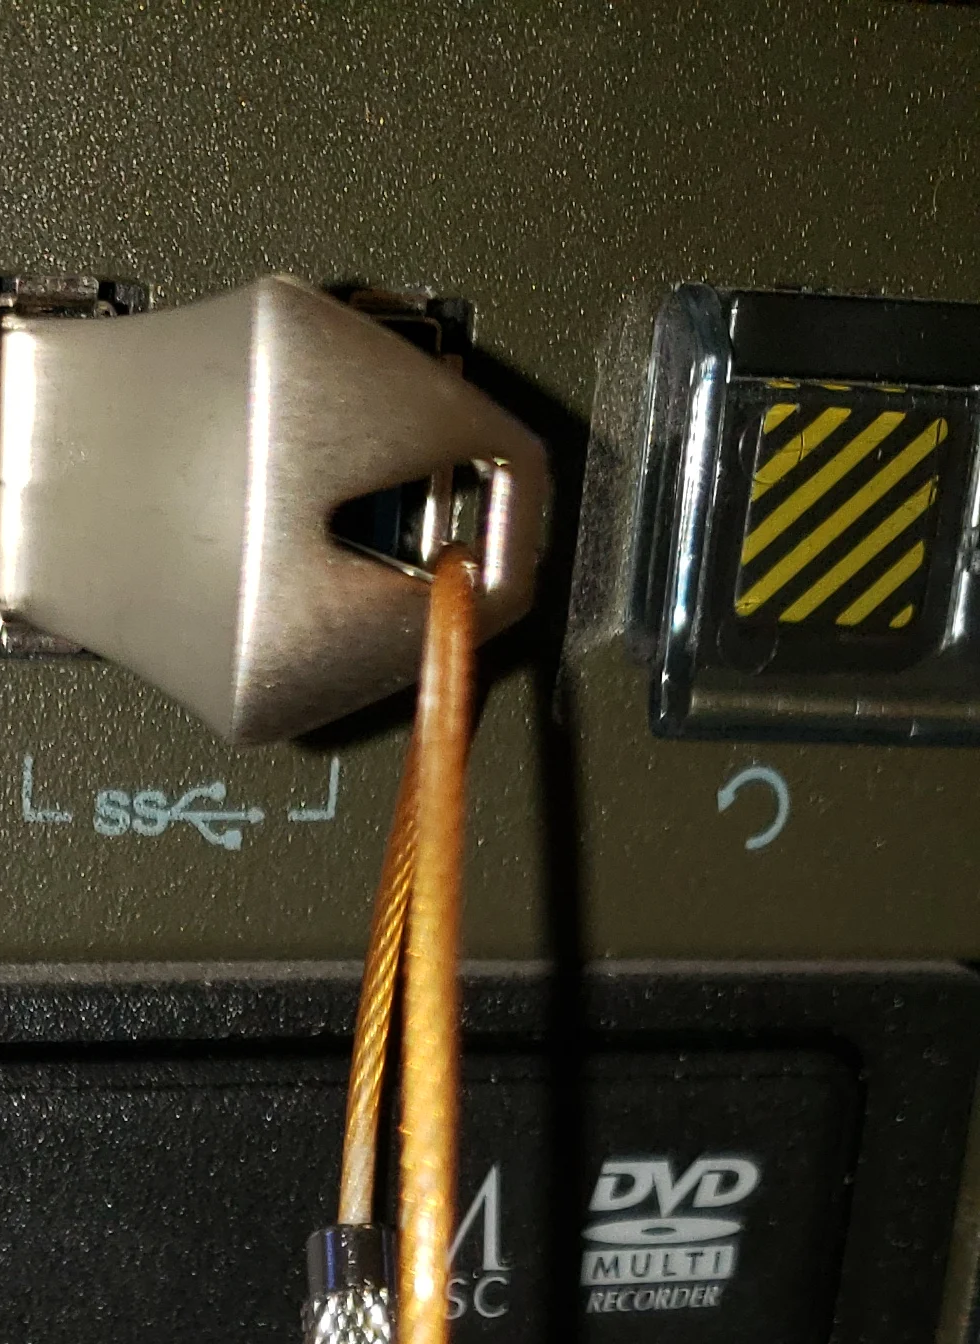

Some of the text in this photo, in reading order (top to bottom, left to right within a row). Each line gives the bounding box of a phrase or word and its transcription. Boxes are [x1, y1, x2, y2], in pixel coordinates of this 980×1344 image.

[587, 1157, 762, 1219] DVD
[591, 1250, 723, 1280] MULTI
[444, 1276, 512, 1320] SC
[585, 1285, 720, 1314] RECORDER
